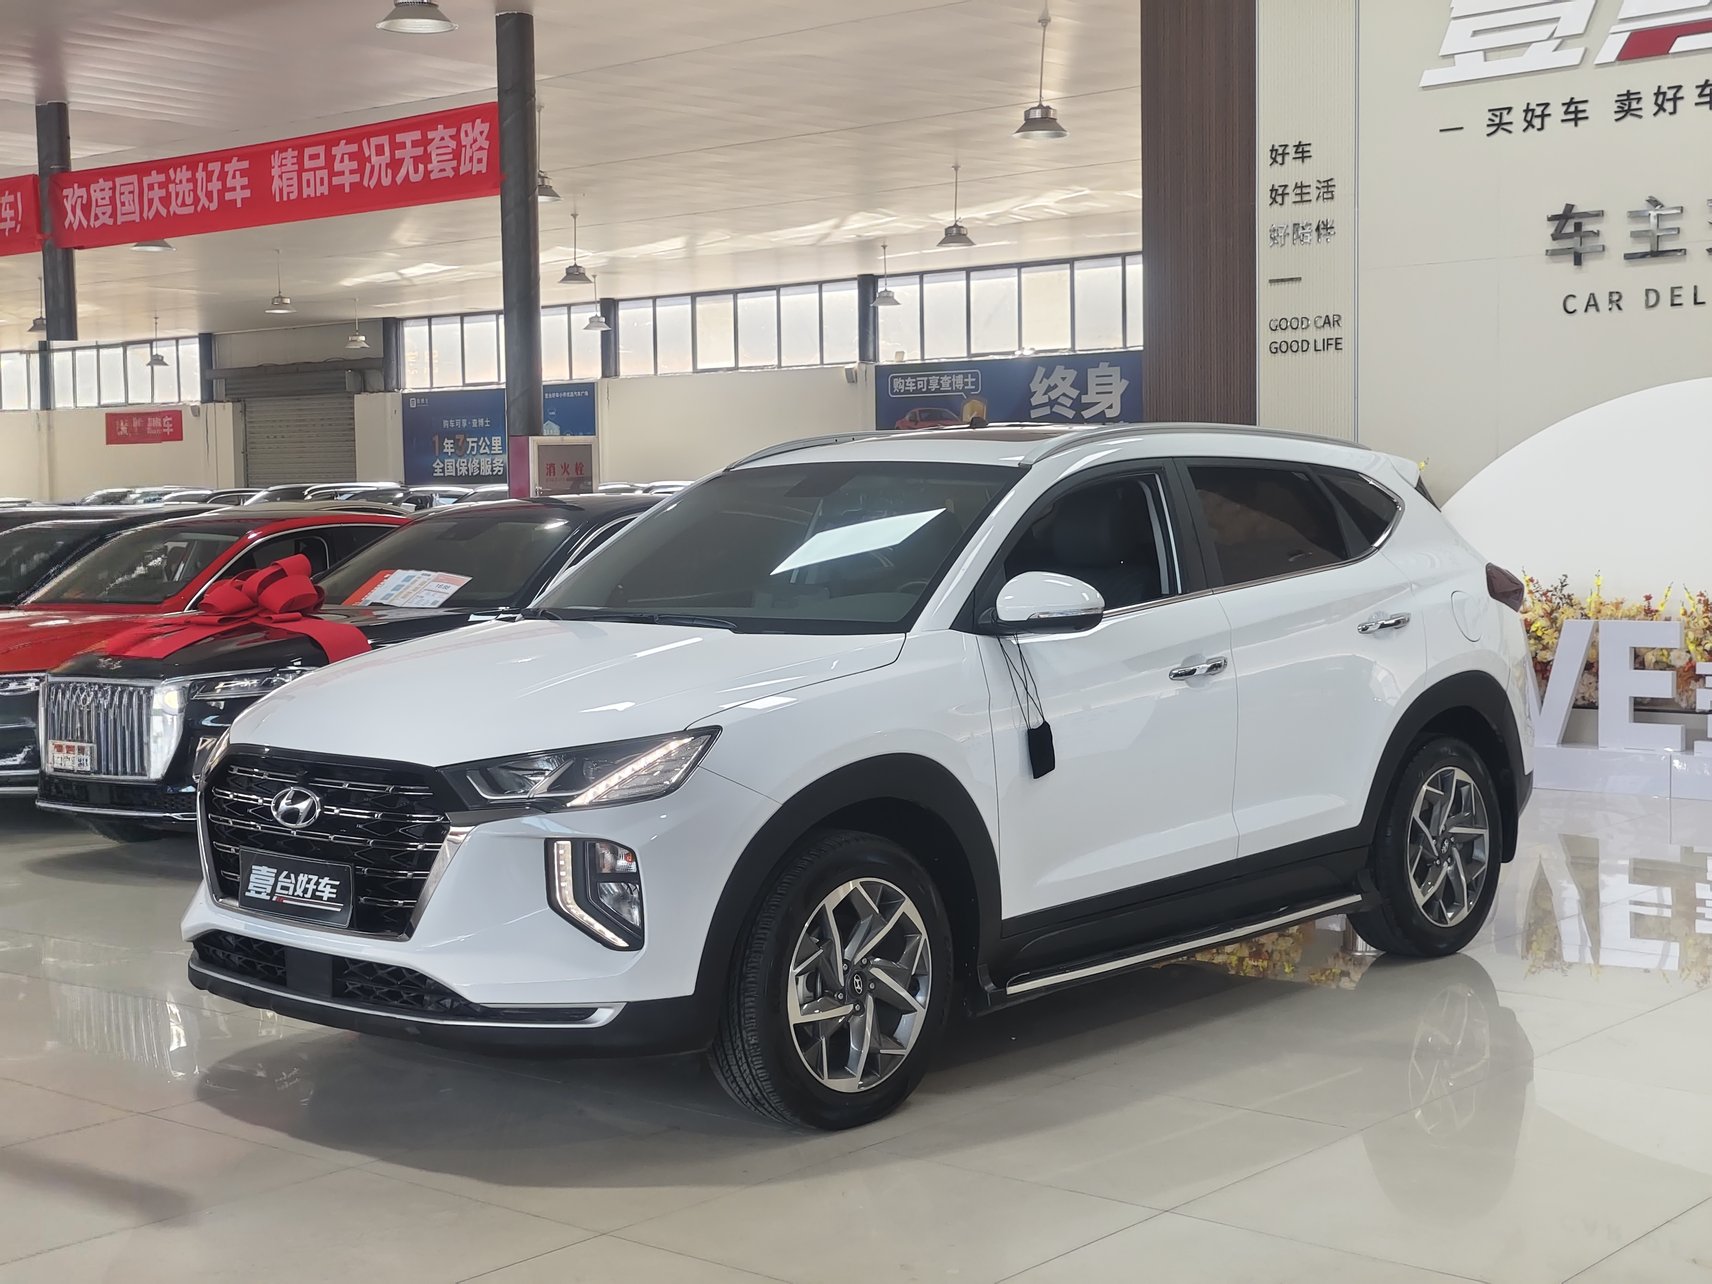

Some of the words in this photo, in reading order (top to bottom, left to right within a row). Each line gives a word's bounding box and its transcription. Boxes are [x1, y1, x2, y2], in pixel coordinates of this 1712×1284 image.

[1486, 96, 1590, 138] 买好车
[1268, 141, 1313, 167] 好车
[62, 156, 252, 230] 欢度国庆选好车
[270, 117, 491, 203] 精品车况无套路
[1268, 178, 1337, 207] 好生活
[1268, 218, 1337, 248] 好陪伴
[1545, 196, 1712, 267] 车主
[1562, 291, 1624, 315] CAR
[1644, 284, 1707, 309] DEL
[1268, 316, 1311, 332] GOOD
[1313, 313, 1343, 329] CAR
[1268, 340, 1311, 355] GOOD
[1313, 337, 1344, 352] LIFE
[892, 374, 977, 393] 购车可享查博士
[1029, 361, 1130, 420] 终身
[432, 457, 505, 477] 全国保修服务
[545, 461, 585, 477] 消火栓
[245, 864, 341, 901] 壹台好车
